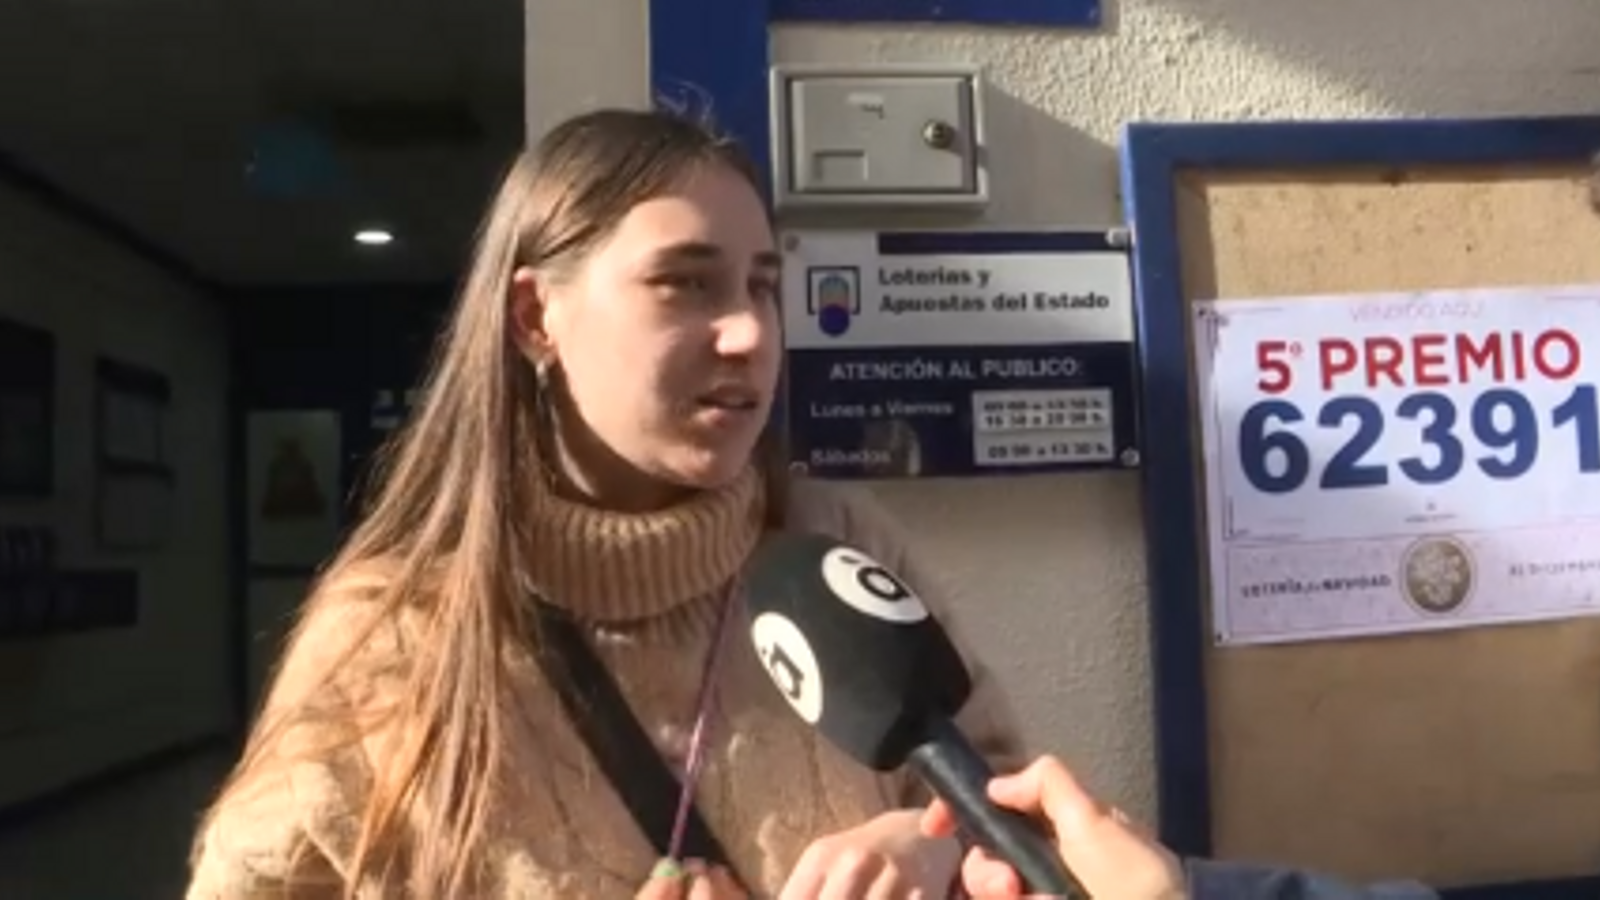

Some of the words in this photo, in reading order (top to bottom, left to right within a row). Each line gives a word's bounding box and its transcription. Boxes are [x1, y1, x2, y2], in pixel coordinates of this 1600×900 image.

[978, 270, 992, 288] y
[879, 294, 986, 315] Apuestas
[992, 293, 1028, 311] del
[1034, 291, 1110, 310] Estado
[829, 358, 943, 381] ATENCIÓN
[949, 360, 977, 379] AL
[1317, 328, 1582, 391] PREMIO
[810, 402, 866, 418] Lunes
[871, 404, 882, 416] a
[886, 400, 954, 416] Viernes
[1238, 382, 1600, 494] 62391
